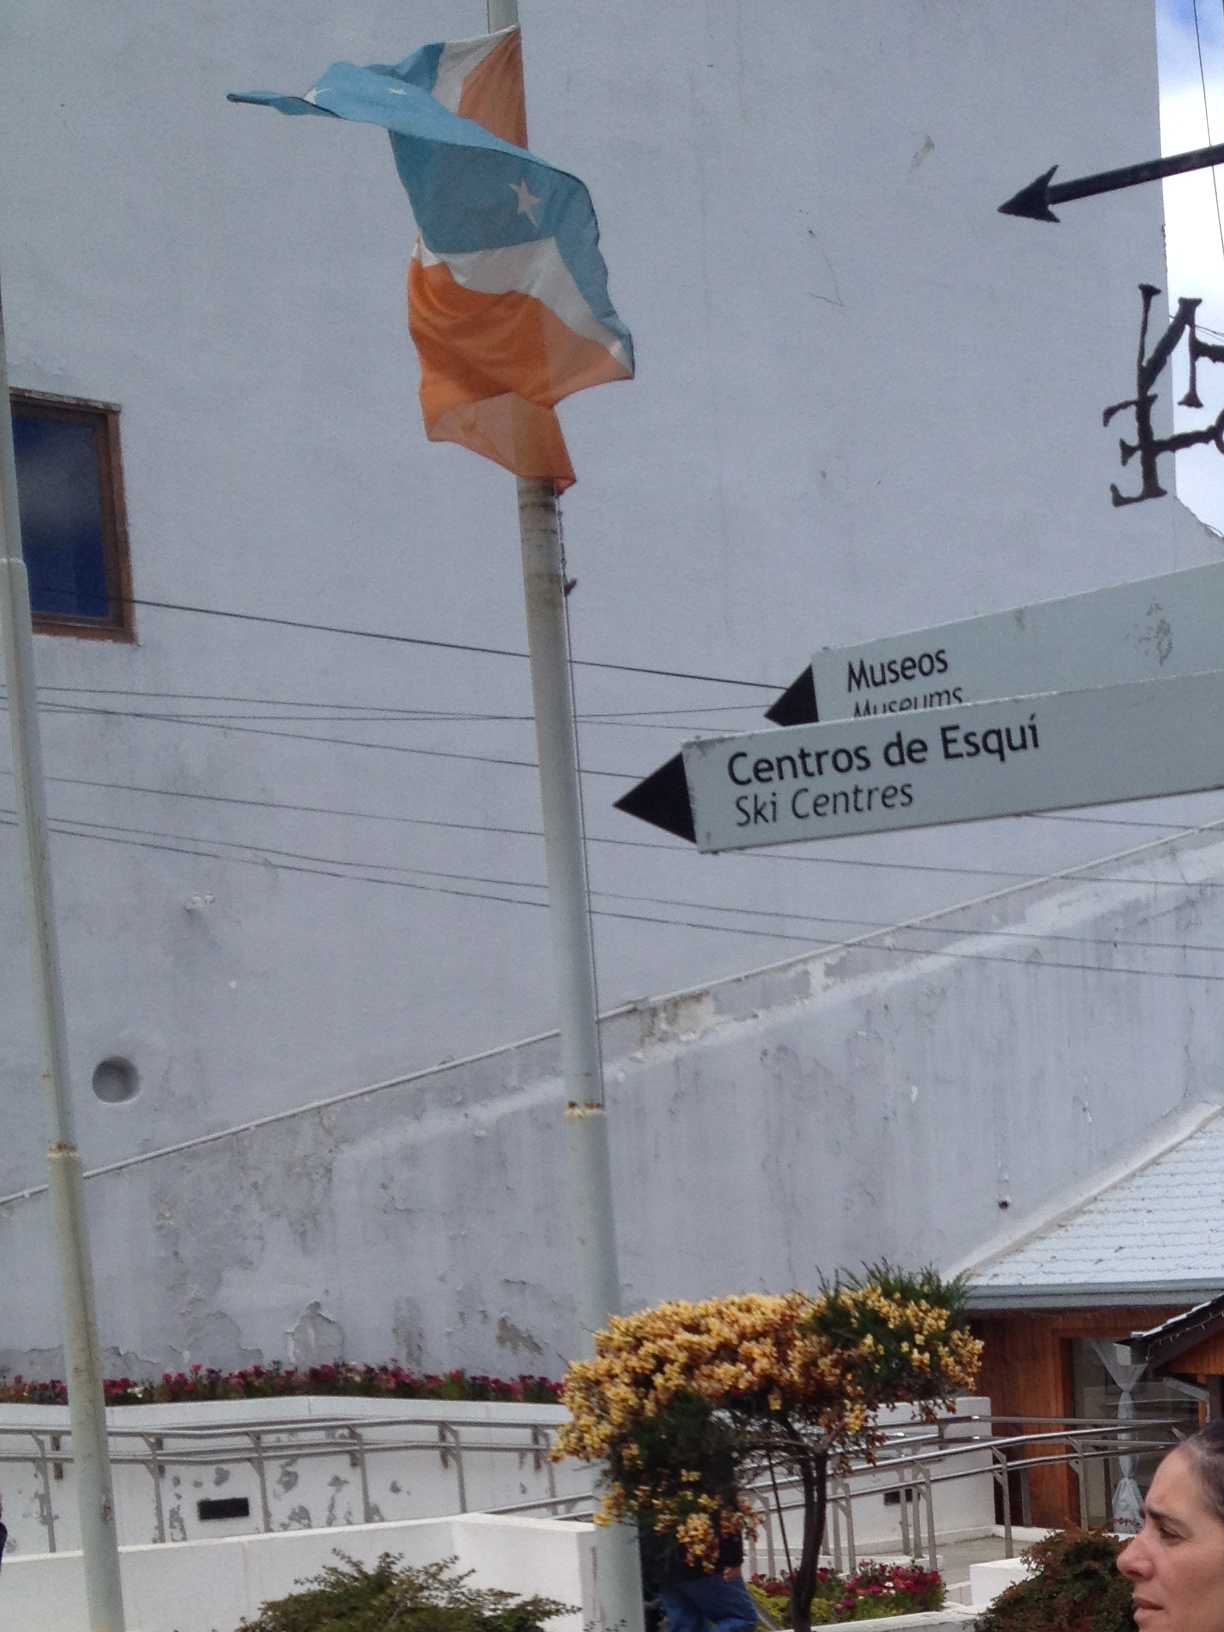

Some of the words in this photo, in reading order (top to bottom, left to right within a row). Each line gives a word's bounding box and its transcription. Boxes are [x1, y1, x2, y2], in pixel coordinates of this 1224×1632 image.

[847, 648, 949, 693] Museos
[727, 741, 871, 786] Centros
[883, 728, 928, 765] de
[940, 713, 1040, 762] Esquí
[735, 793, 778, 827] Ski
[791, 780, 914, 820] Centres
